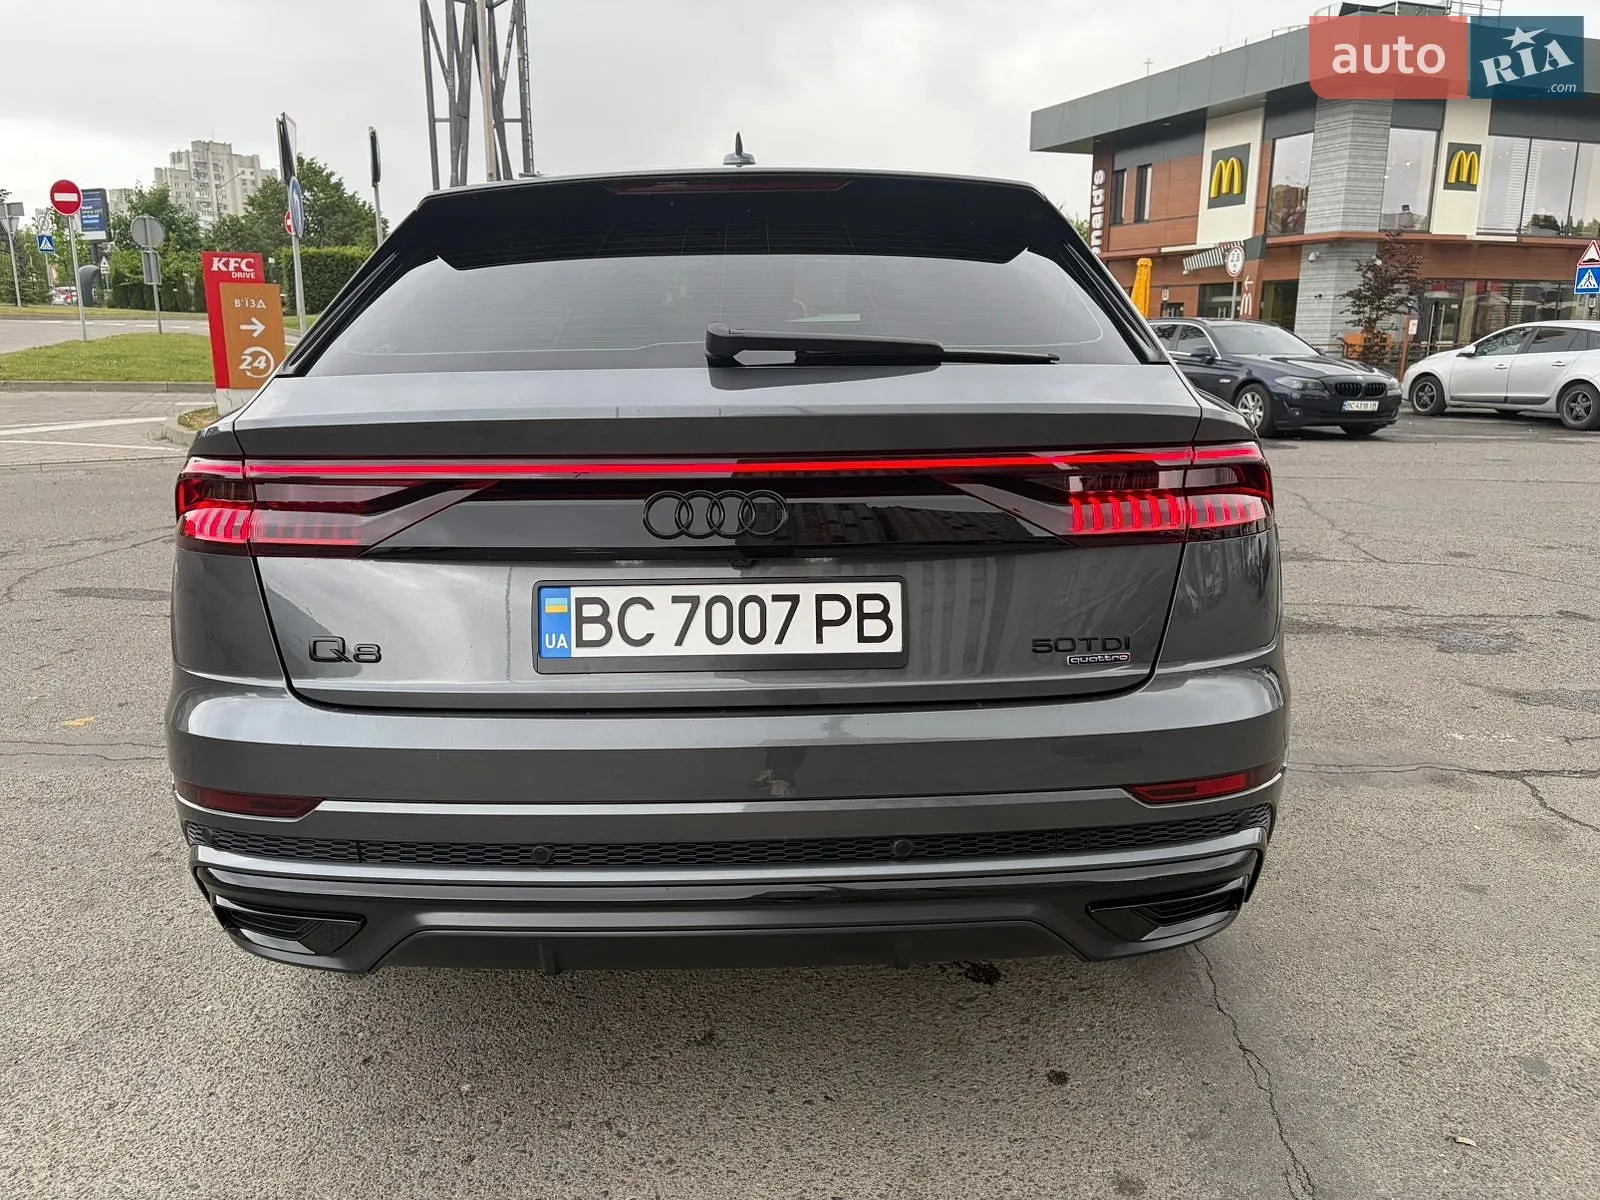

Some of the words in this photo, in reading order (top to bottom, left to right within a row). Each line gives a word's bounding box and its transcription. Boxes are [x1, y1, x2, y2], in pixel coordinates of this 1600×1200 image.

[211, 257, 255, 272] KFC
[231, 271, 256, 279] DRIVE
[238, 355, 267, 370] 24
[574, 596, 655, 648] BC
[671, 594, 800, 647] 7007
[814, 593, 894, 645] PB
[544, 633, 568, 649] UA
[309, 636, 382, 663] Q8
[1070, 654, 1128, 664] quattro
